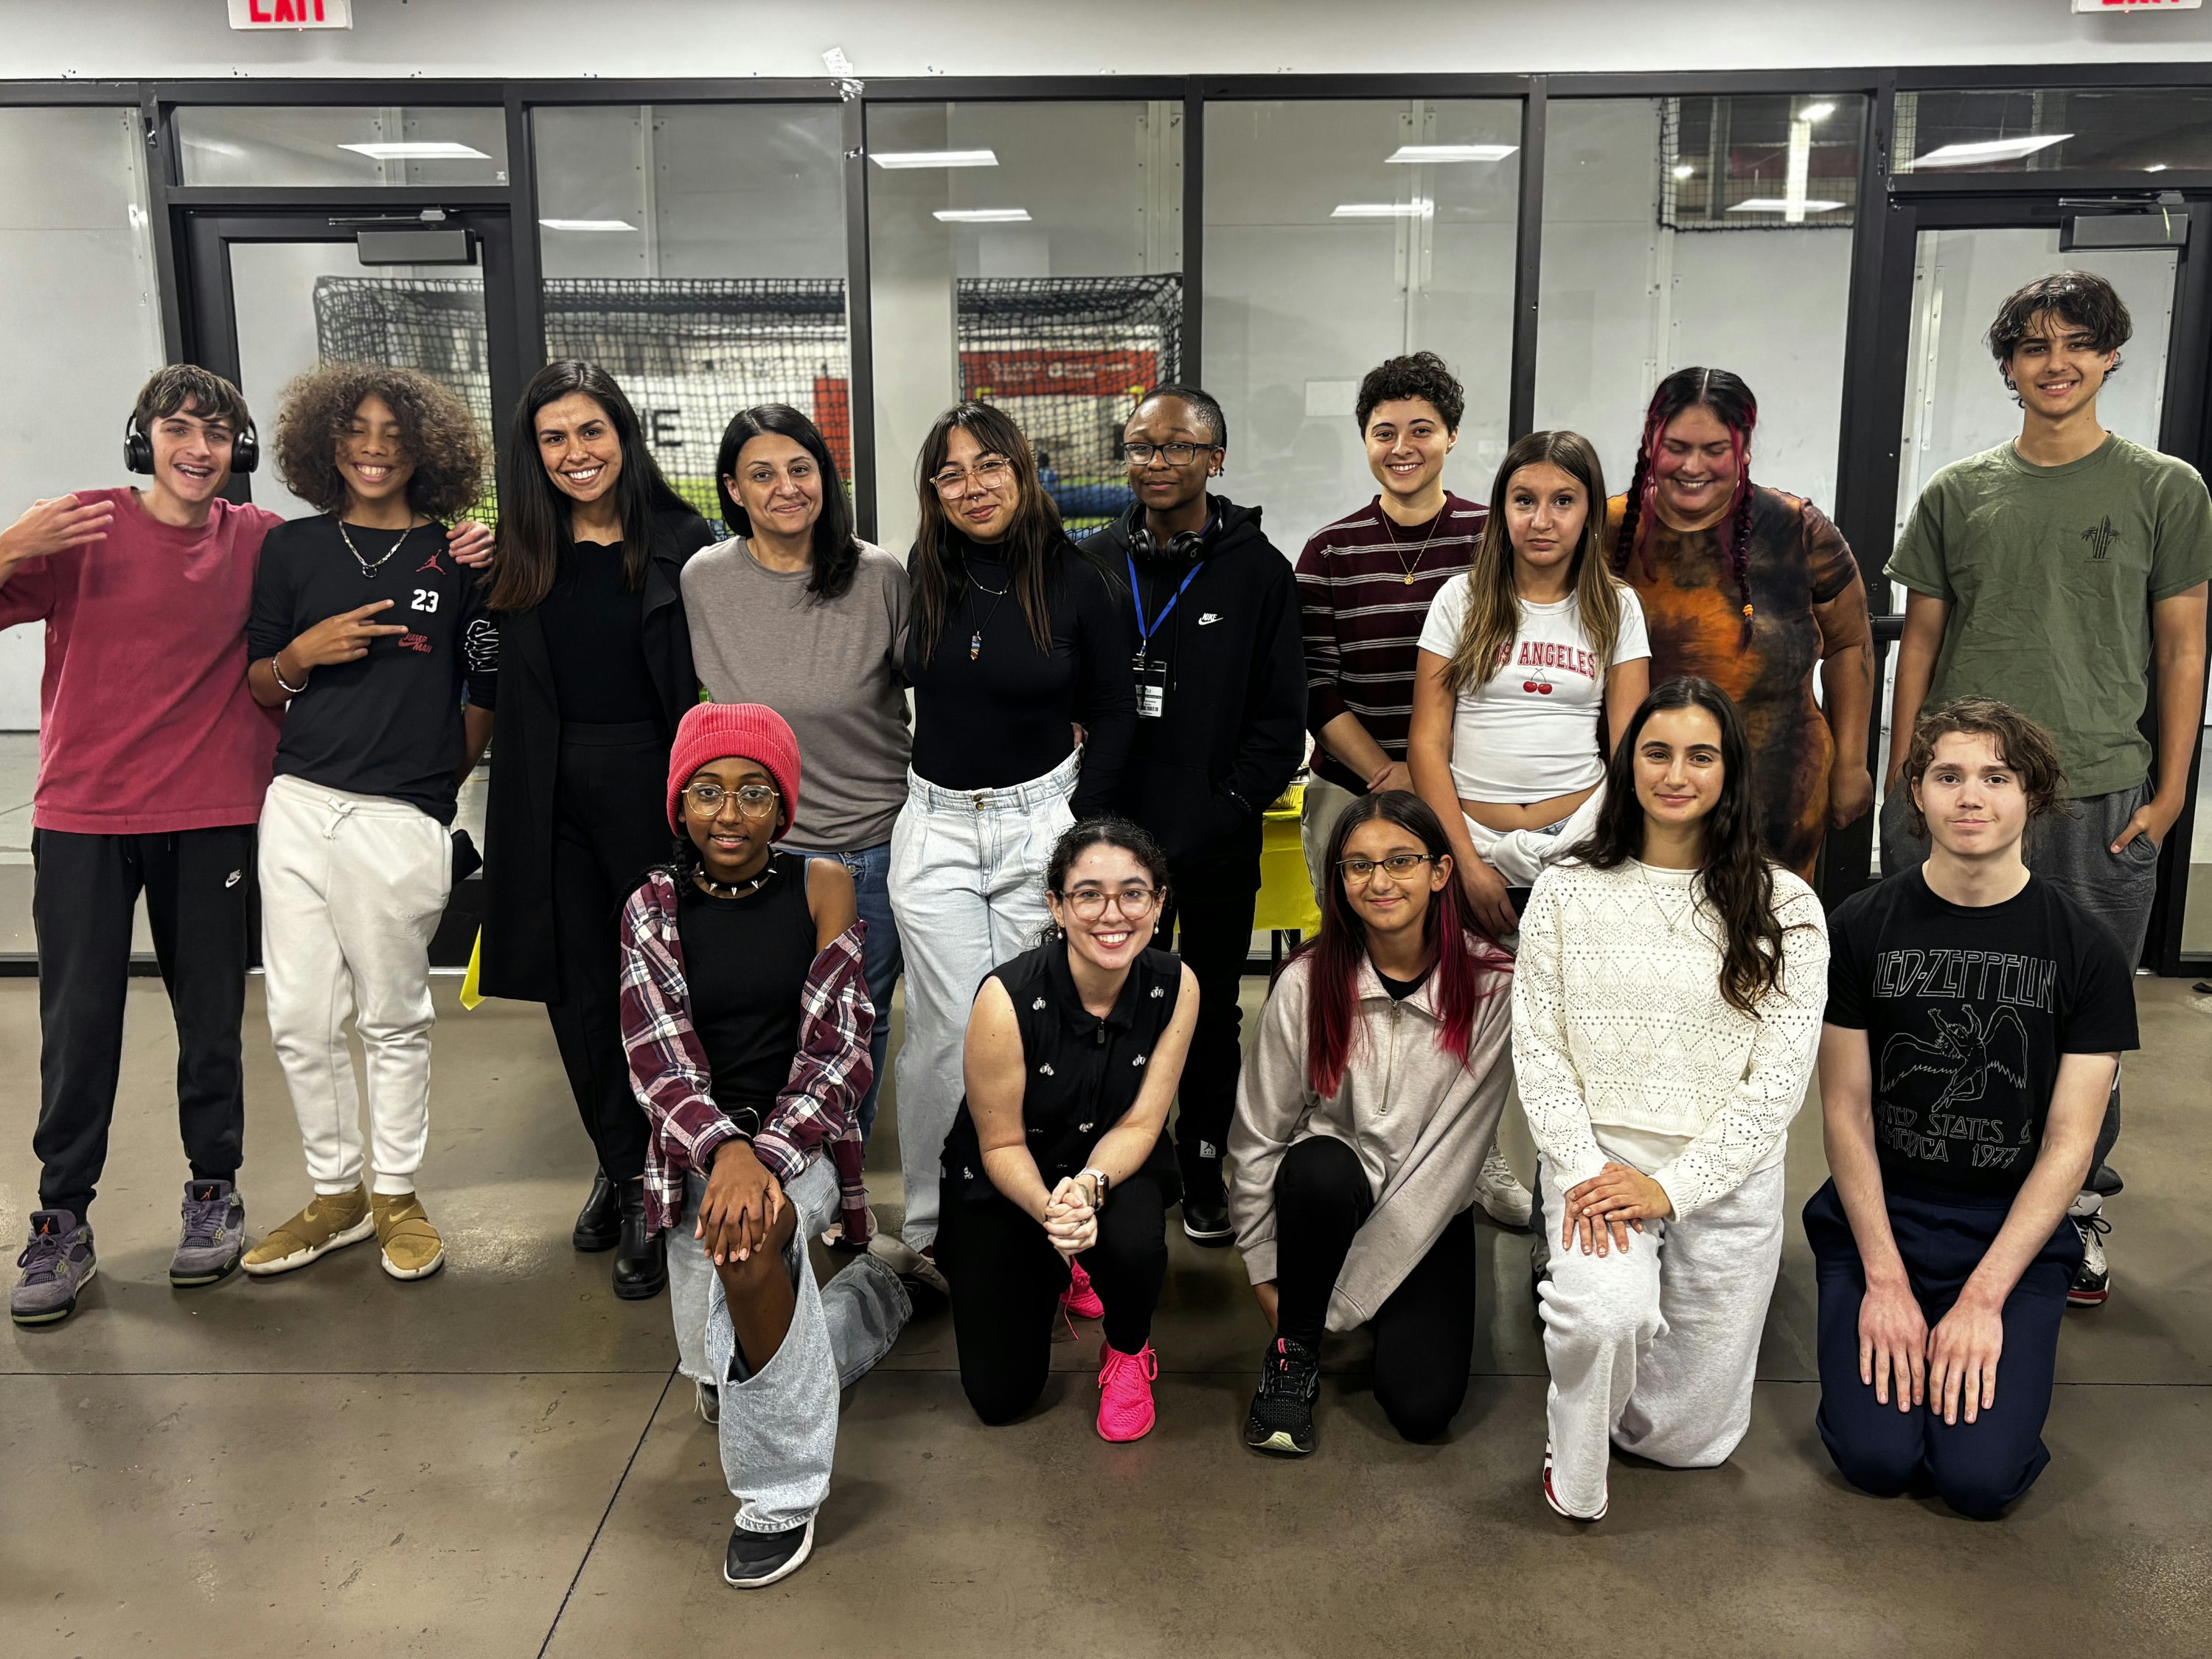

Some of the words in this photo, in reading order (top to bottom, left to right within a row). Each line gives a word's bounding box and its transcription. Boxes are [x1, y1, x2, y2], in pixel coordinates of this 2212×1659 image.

[411, 589, 439, 613] 23
[1517, 641, 1596, 681] ANGELES
[1927, 1113, 2004, 1144] STATES
[1972, 1143, 2021, 1169] 1977
